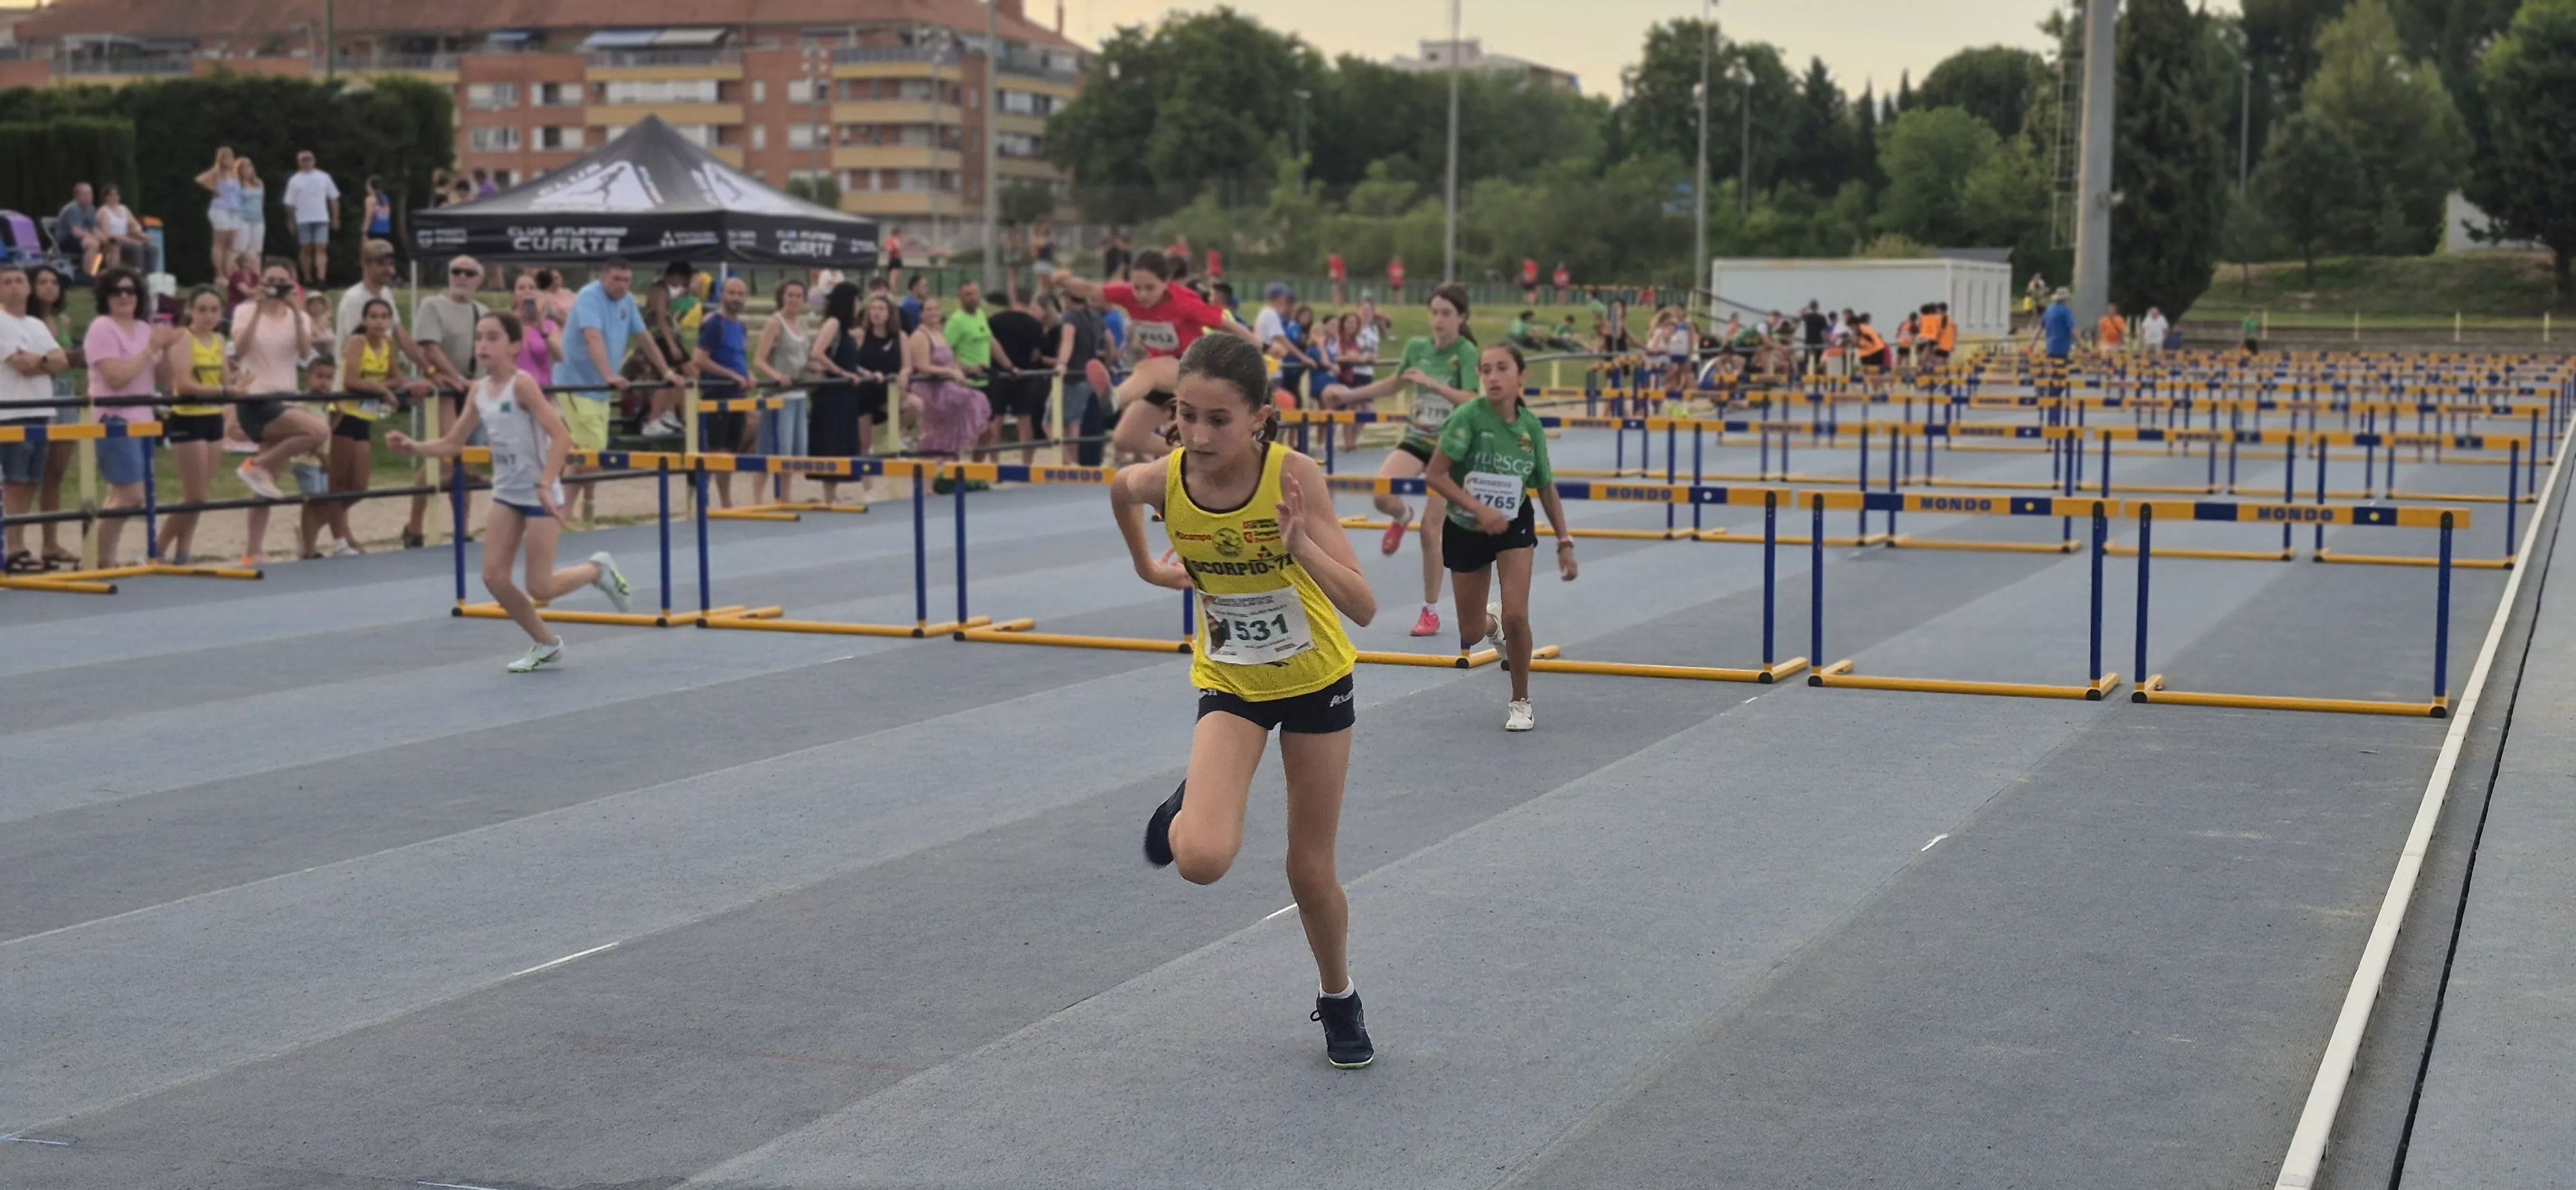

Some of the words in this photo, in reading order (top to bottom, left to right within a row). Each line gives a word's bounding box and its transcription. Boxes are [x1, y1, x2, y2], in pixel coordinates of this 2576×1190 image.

[513, 236, 620, 254] CUARTE
[1045, 469, 1102, 482] MONDO
[1606, 486, 1672, 501] MONDO
[1920, 497, 1991, 511] MONDO
[2257, 507, 2333, 522] MONDO
[1218, 613, 1289, 641] 1531
